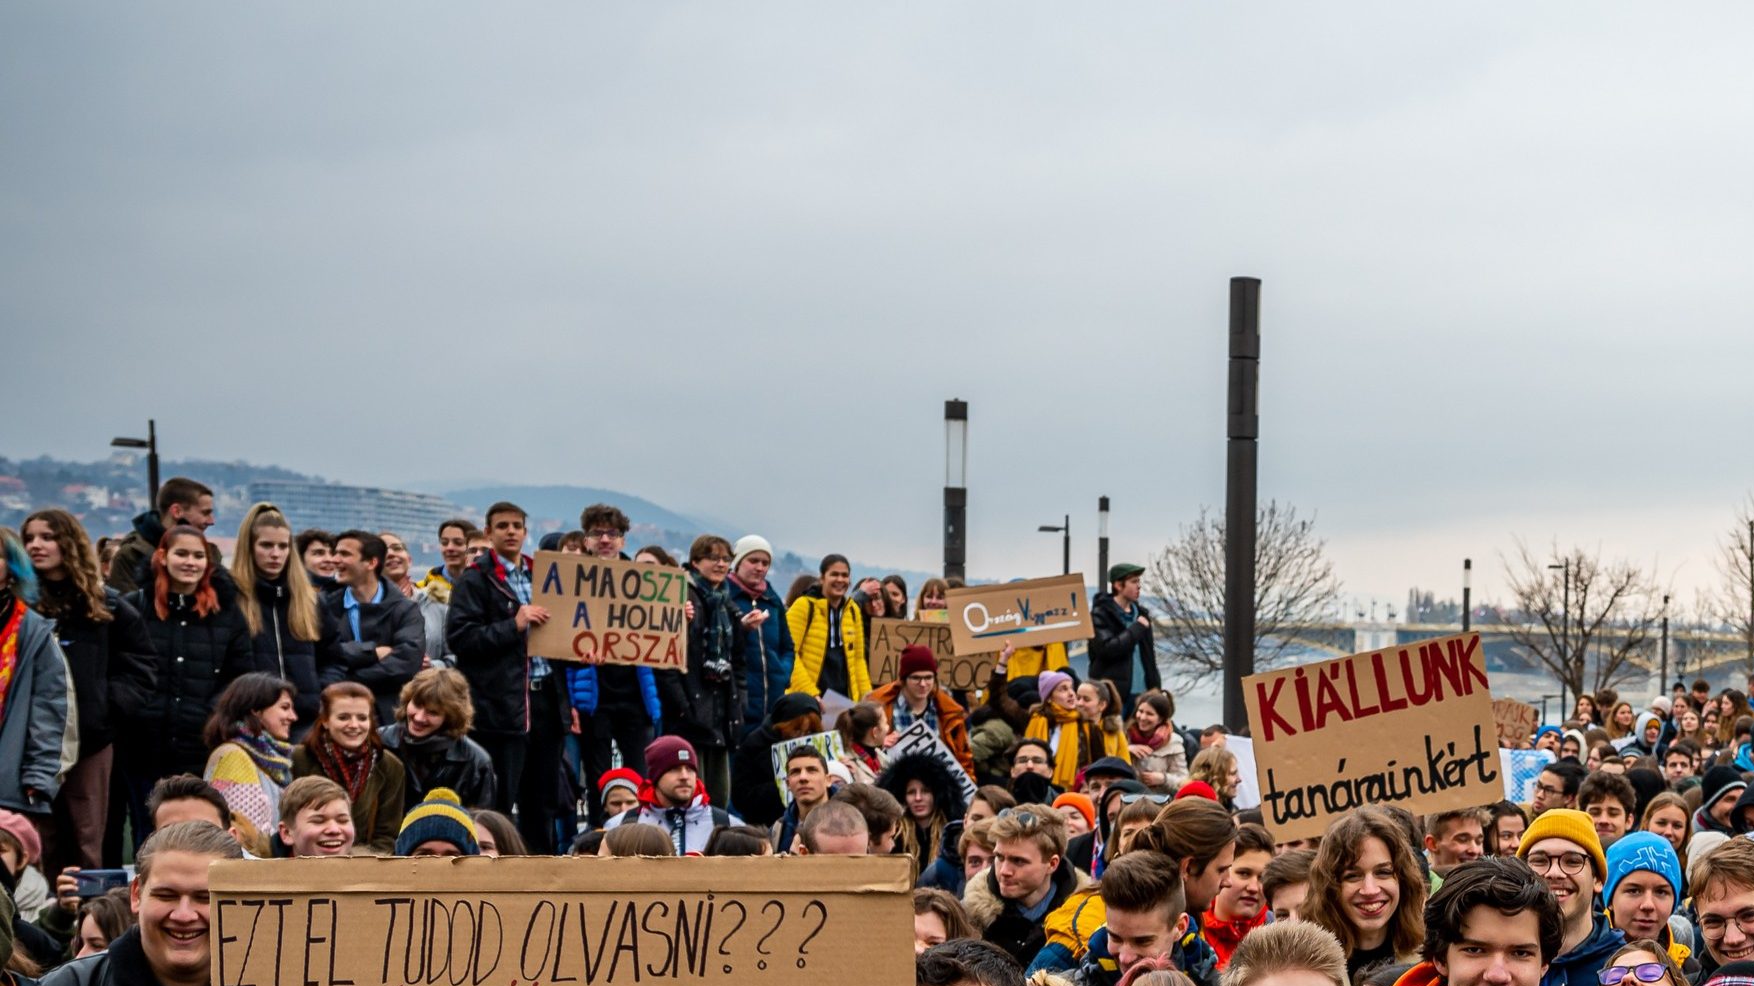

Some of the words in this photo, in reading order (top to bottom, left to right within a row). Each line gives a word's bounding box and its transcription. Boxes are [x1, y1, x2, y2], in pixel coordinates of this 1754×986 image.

[541, 561, 563, 595] A
[574, 563, 616, 599] MA
[572, 601, 591, 630] A
[1256, 635, 1489, 742] KIÁLLUNK
[1264, 724, 1497, 825] tanárainkért
[303, 898, 355, 986] EL
[376, 896, 503, 986] TUDOD
